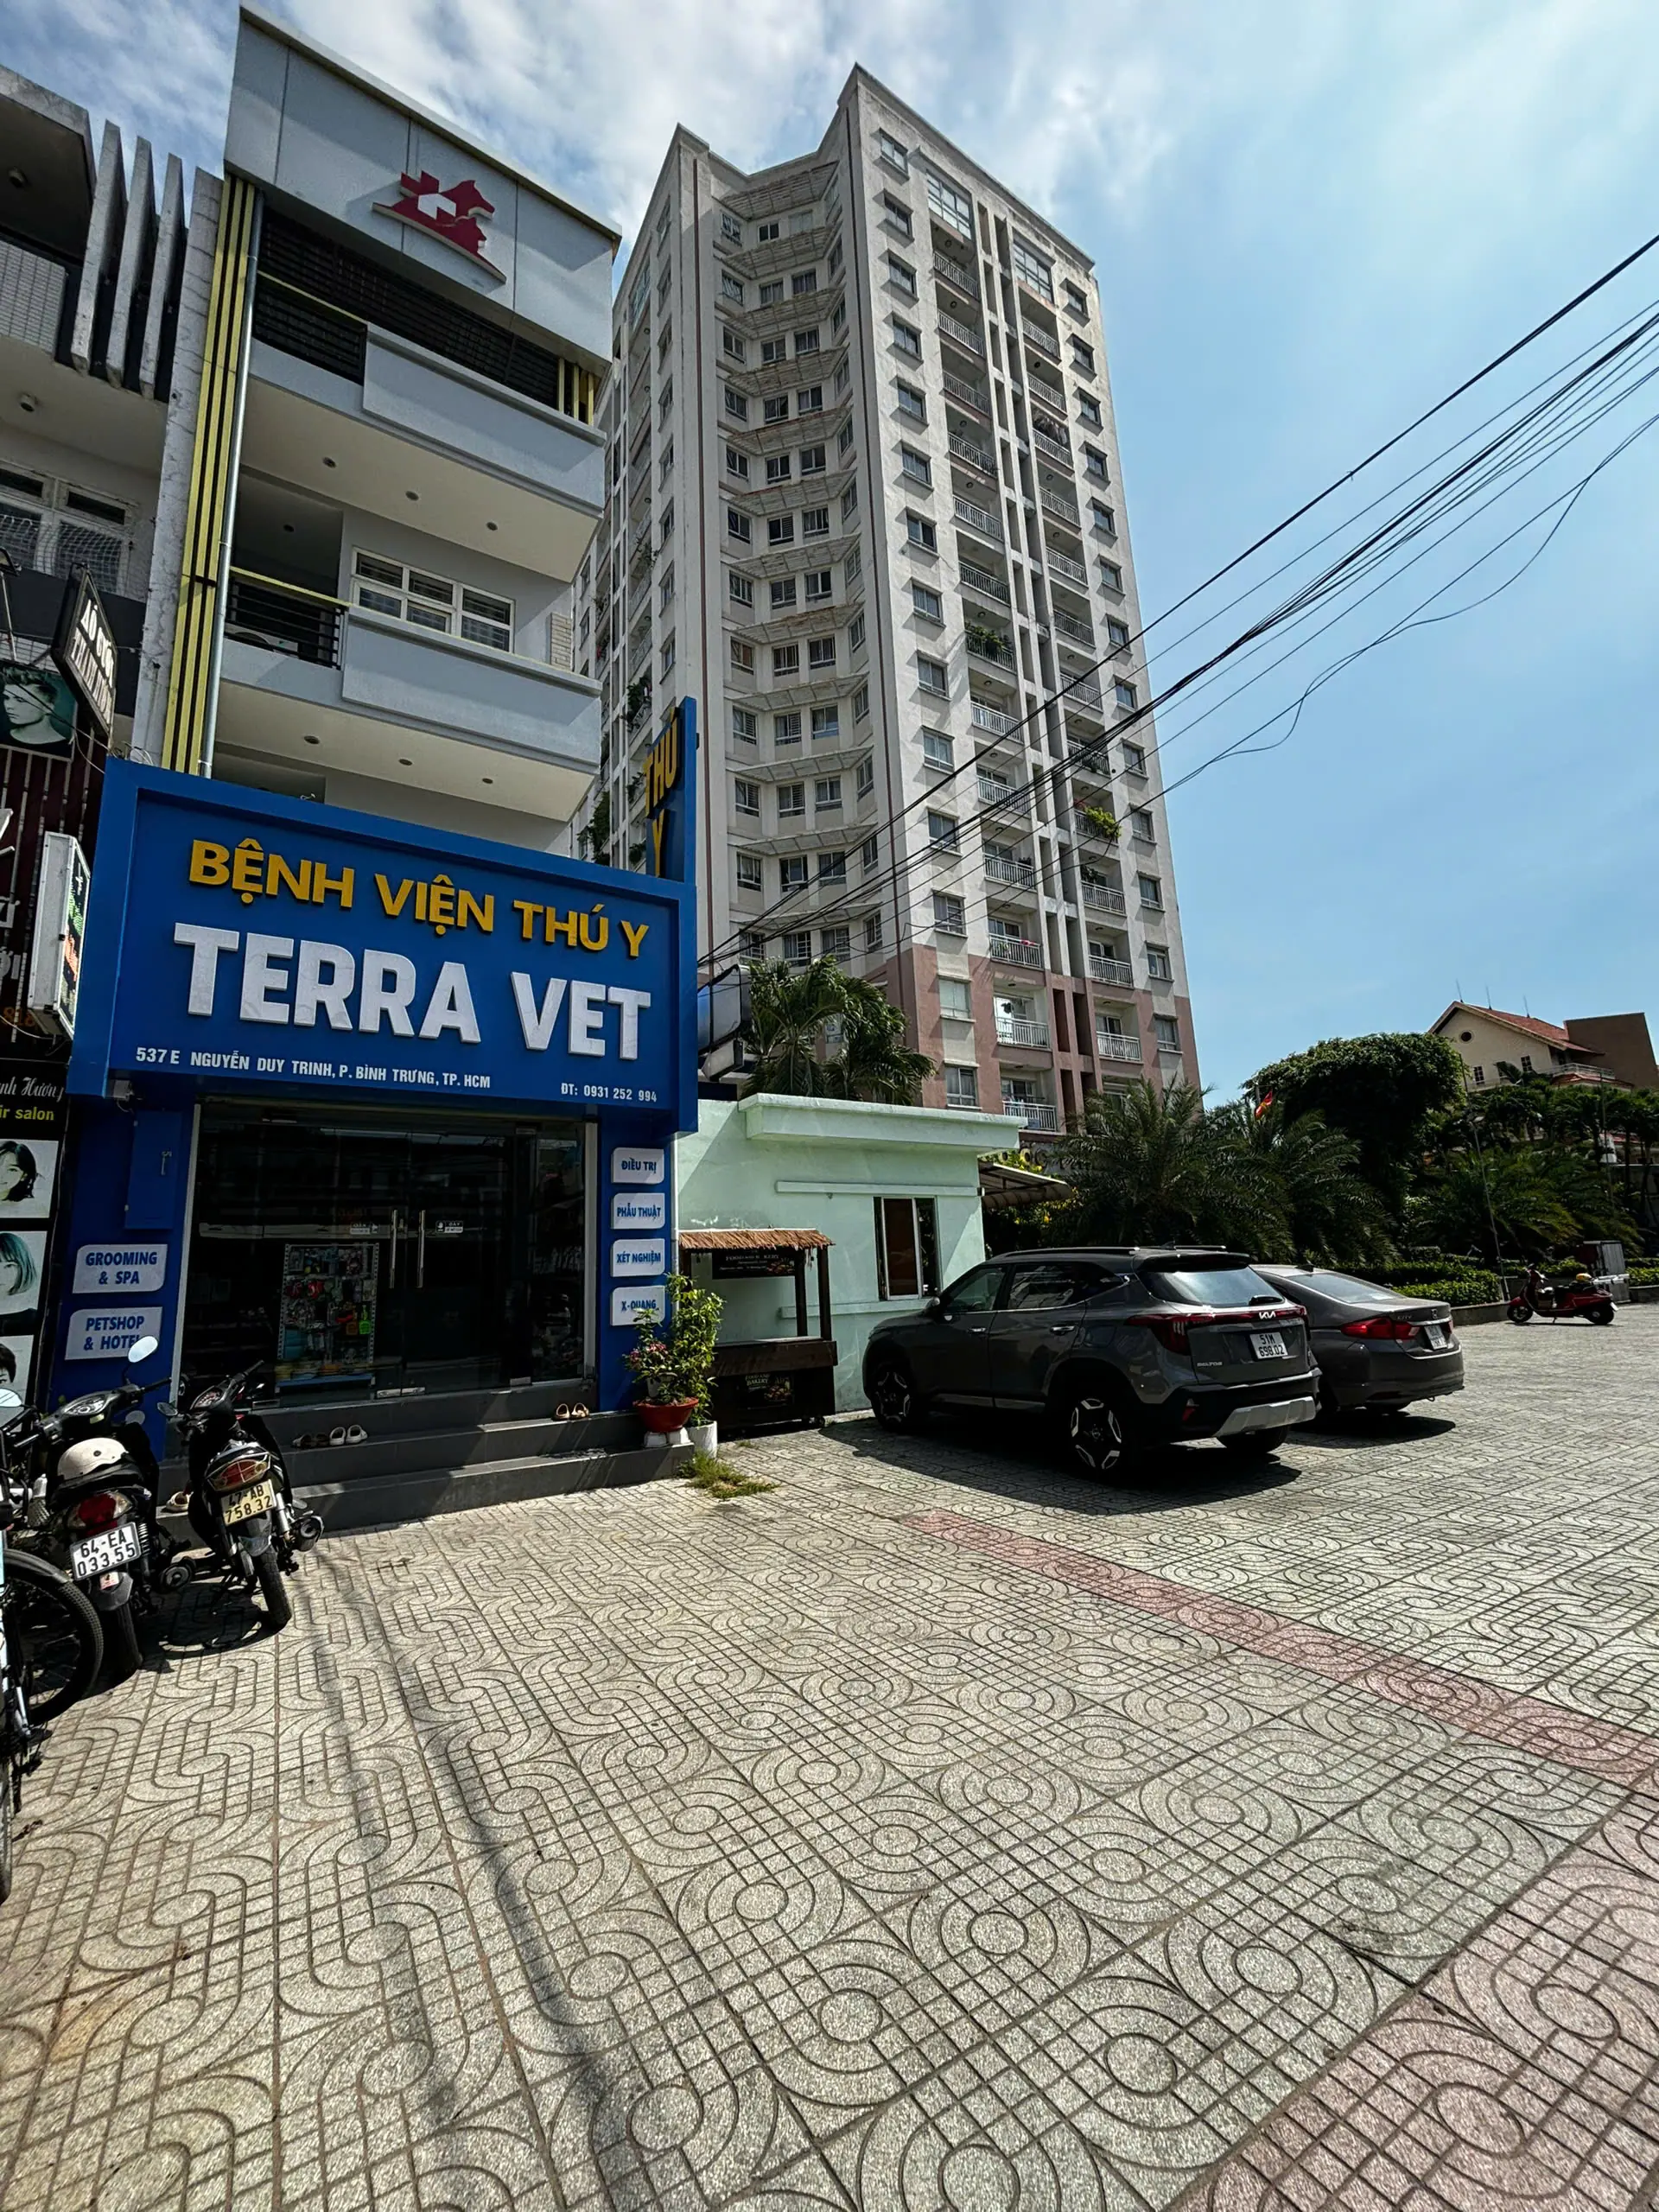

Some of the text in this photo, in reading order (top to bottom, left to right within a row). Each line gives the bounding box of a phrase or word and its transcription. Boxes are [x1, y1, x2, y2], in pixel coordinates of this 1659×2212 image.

[643, 706, 678, 818] THÚ
[652, 808, 665, 878] Y
[188, 837, 650, 957] BỆNH VIỆN THÚ Y
[174, 922, 481, 1044] TERRA
[510, 971, 651, 1061] VET
[190, 1050, 250, 1071] NGUYỄN
[257, 1057, 285, 1073] DUY
[291, 1060, 336, 1079] TRINH,
[339, 1064, 353, 1079] P.
[355, 1064, 388, 1082] BÌNH
[391, 1068, 440, 1086] TRƯNG,
[442, 1072, 461, 1087] TP.
[463, 1074, 491, 1089] HCM
[561, 1082, 658, 1103] ĐT: 0931 252 994
[15, 1106, 54, 1121] salon
[621, 1156, 657, 1174] ĐIỀU TRỊ
[638, 1206, 661, 1221] THUẬT
[86, 1251, 158, 1267] GROOMING
[616, 1249, 661, 1266] XÉT NGHIỆM
[99, 1271, 140, 1285] & SPA
[86, 1315, 145, 1332] PETSHOP
[83, 1336, 94, 1351] &
[1259, 1333, 1276, 1345] 51M
[1258, 1344, 1285, 1357] 698.02
[228, 1484, 265, 1509] 47-AB
[225, 1495, 273, 1524] 758.32
[80, 1529, 127, 1558] 64-EA
[77, 1542, 136, 1578] 033.55
